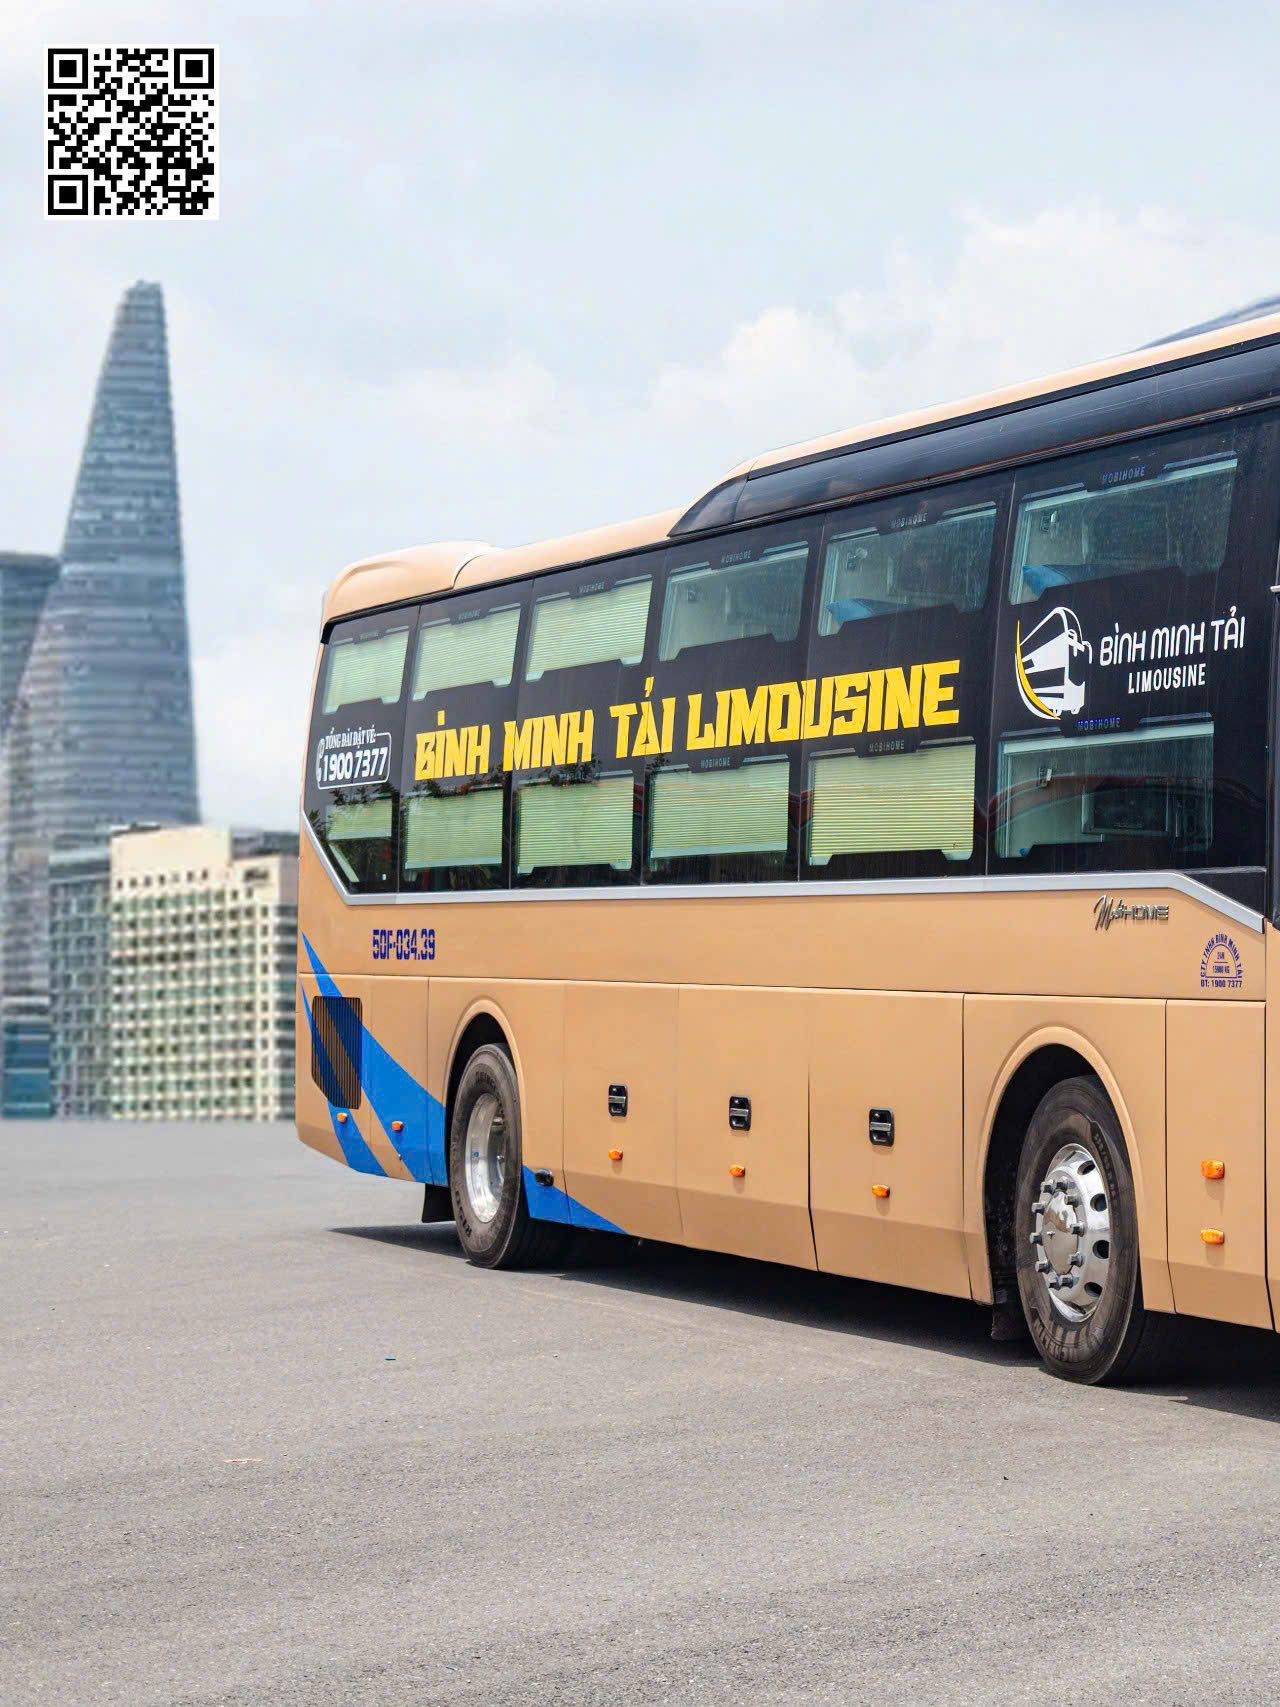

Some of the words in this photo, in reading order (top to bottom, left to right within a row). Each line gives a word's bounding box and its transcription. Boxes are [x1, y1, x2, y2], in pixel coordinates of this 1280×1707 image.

[1099, 622, 1147, 667] BÌNH
[1150, 621, 1206, 661] MINH
[1210, 605, 1246, 652] TẢI
[1127, 663, 1207, 694] LIMOUSINE
[414, 709, 491, 781] BÌNH
[502, 709, 595, 772] MINH
[609, 676, 676, 759] TẢI
[686, 659, 961, 751] LIMOUSINE
[868, 739, 905, 752] MOBIHOME
[323, 751, 354, 782] 1900
[353, 746, 389, 779] 7377
[372, 928, 436, 961] 50F-034.39
[1211, 979, 1226, 988] 1900
[1227, 979, 1243, 988] 7377
